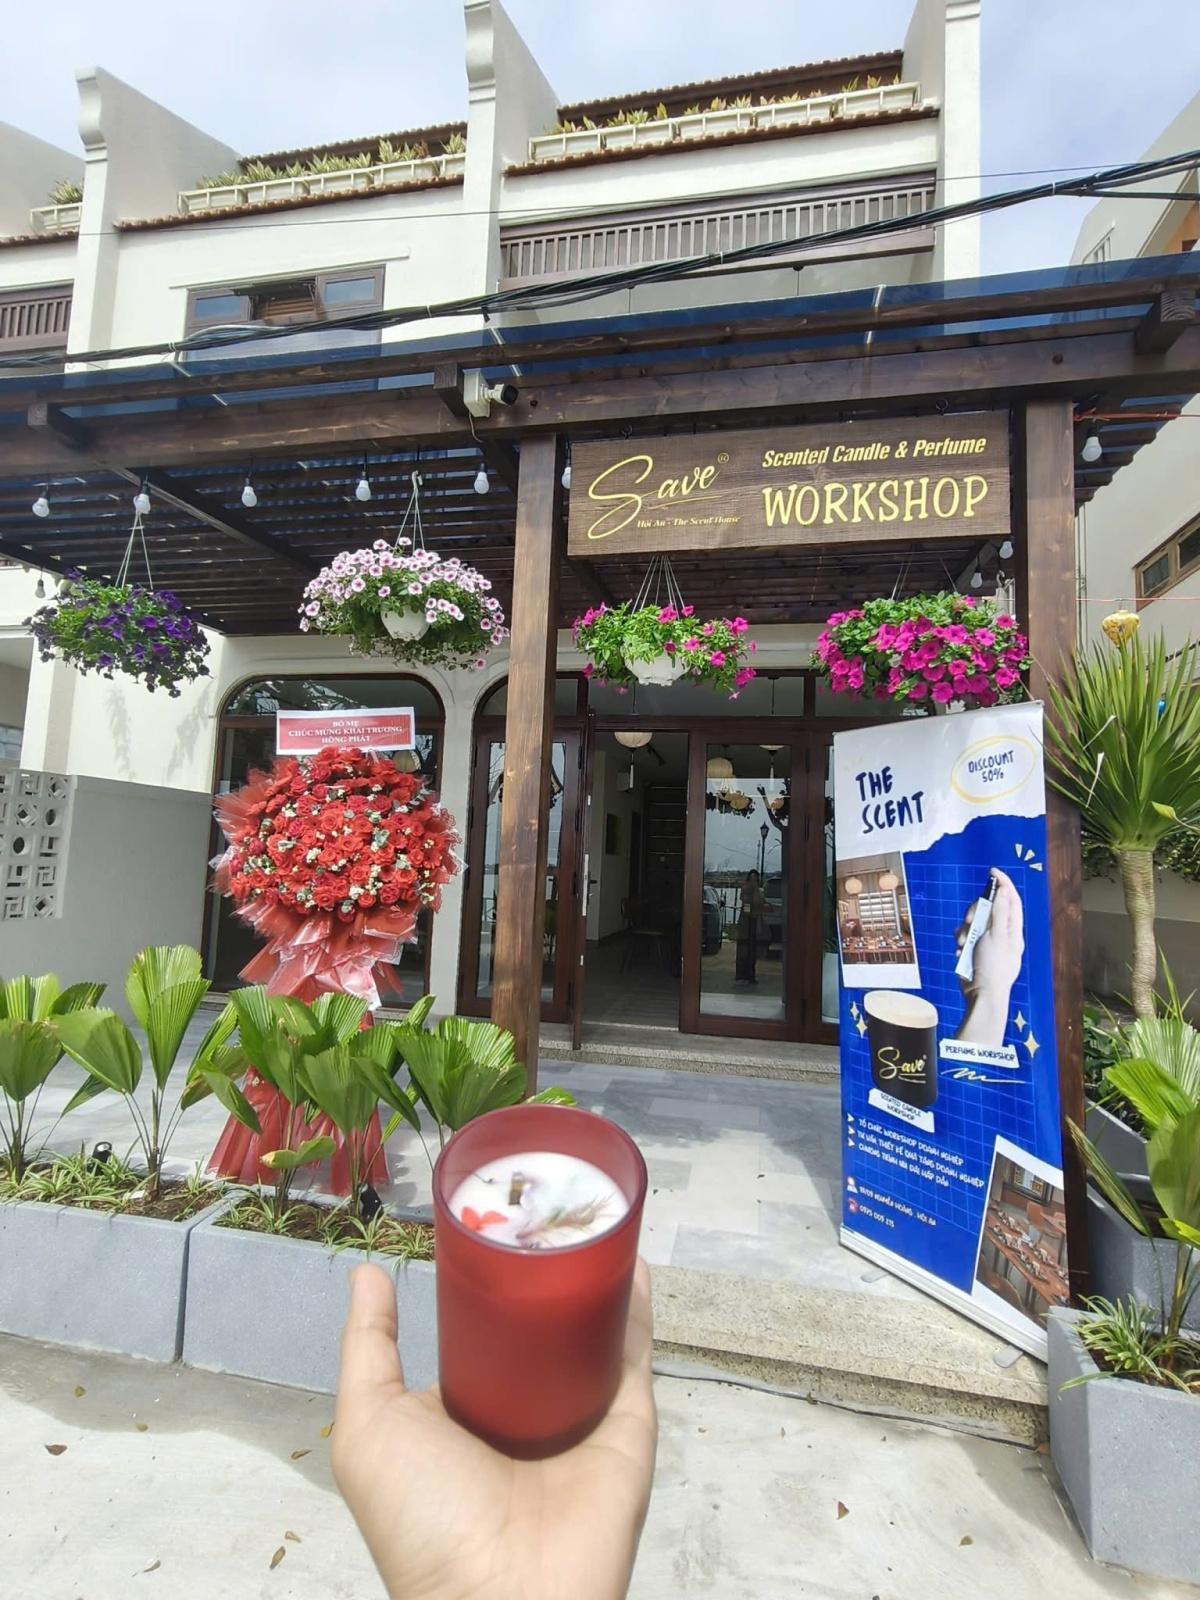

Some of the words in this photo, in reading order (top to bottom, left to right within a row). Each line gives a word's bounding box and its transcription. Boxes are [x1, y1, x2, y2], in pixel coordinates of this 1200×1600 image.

[762, 449, 829, 469] Scented
[832, 444, 890, 464] Candle
[894, 441, 906, 458] &
[912, 437, 987, 458] Perfume
[587, 454, 720, 539] Save
[762, 474, 989, 527] WORKSHOP
[673, 518, 688, 526] The
[343, 727, 365, 735] KHAI
[968, 750, 1014, 773] DISCOUNT
[855, 766, 893, 802] THE
[982, 768, 1004, 783] 50%
[862, 791, 924, 834] SCENT
[877, 1046, 926, 1080] Save
[945, 1046, 976, 1056] PERFUME
[978, 1049, 1015, 1061] WORKSHOP
[883, 1128, 917, 1147] WORKSHOP
